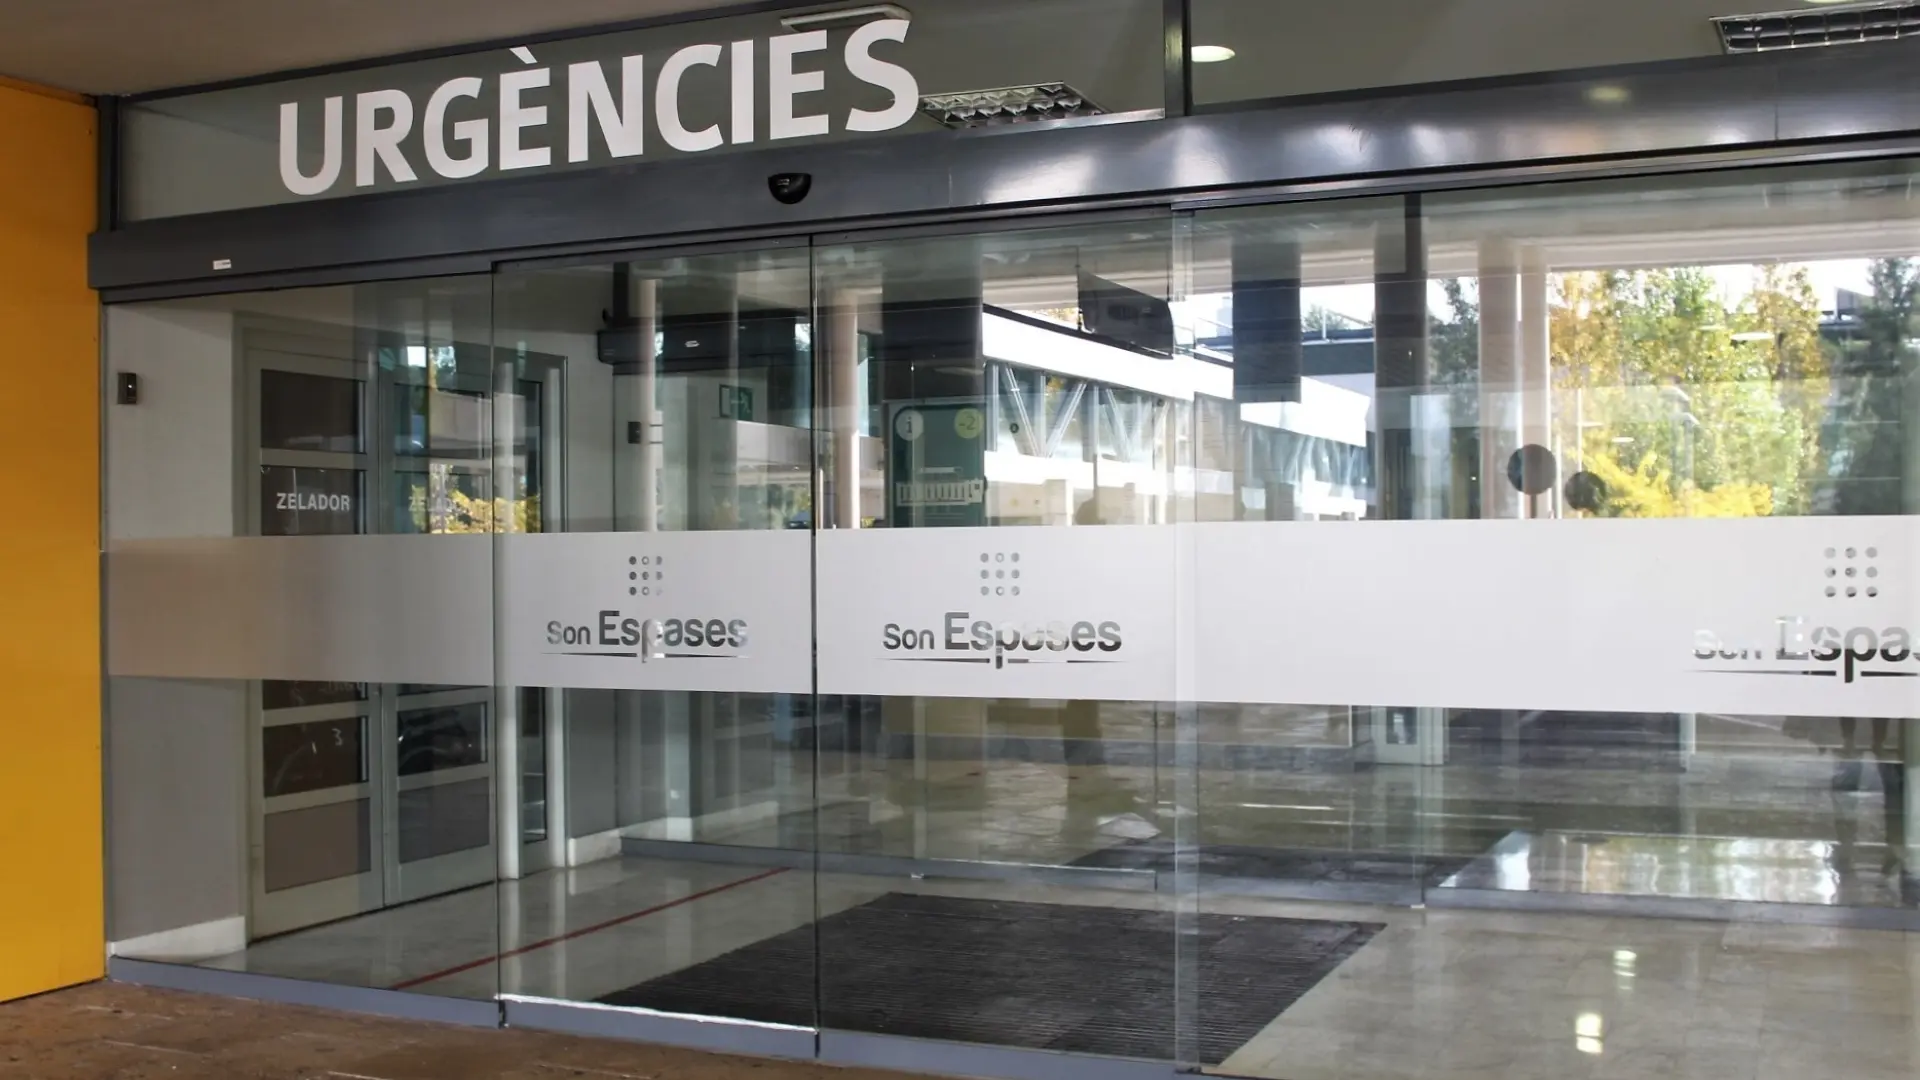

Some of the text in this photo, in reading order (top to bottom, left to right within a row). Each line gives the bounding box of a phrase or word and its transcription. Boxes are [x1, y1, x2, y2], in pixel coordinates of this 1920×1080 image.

[279, 19, 920, 196] URGÈNCIES
[276, 492, 351, 511] ZELADOR
[547, 610, 749, 663] Son Espases
[882, 611, 1123, 670] Son Espases
[1775, 614, 1920, 683] Espa
